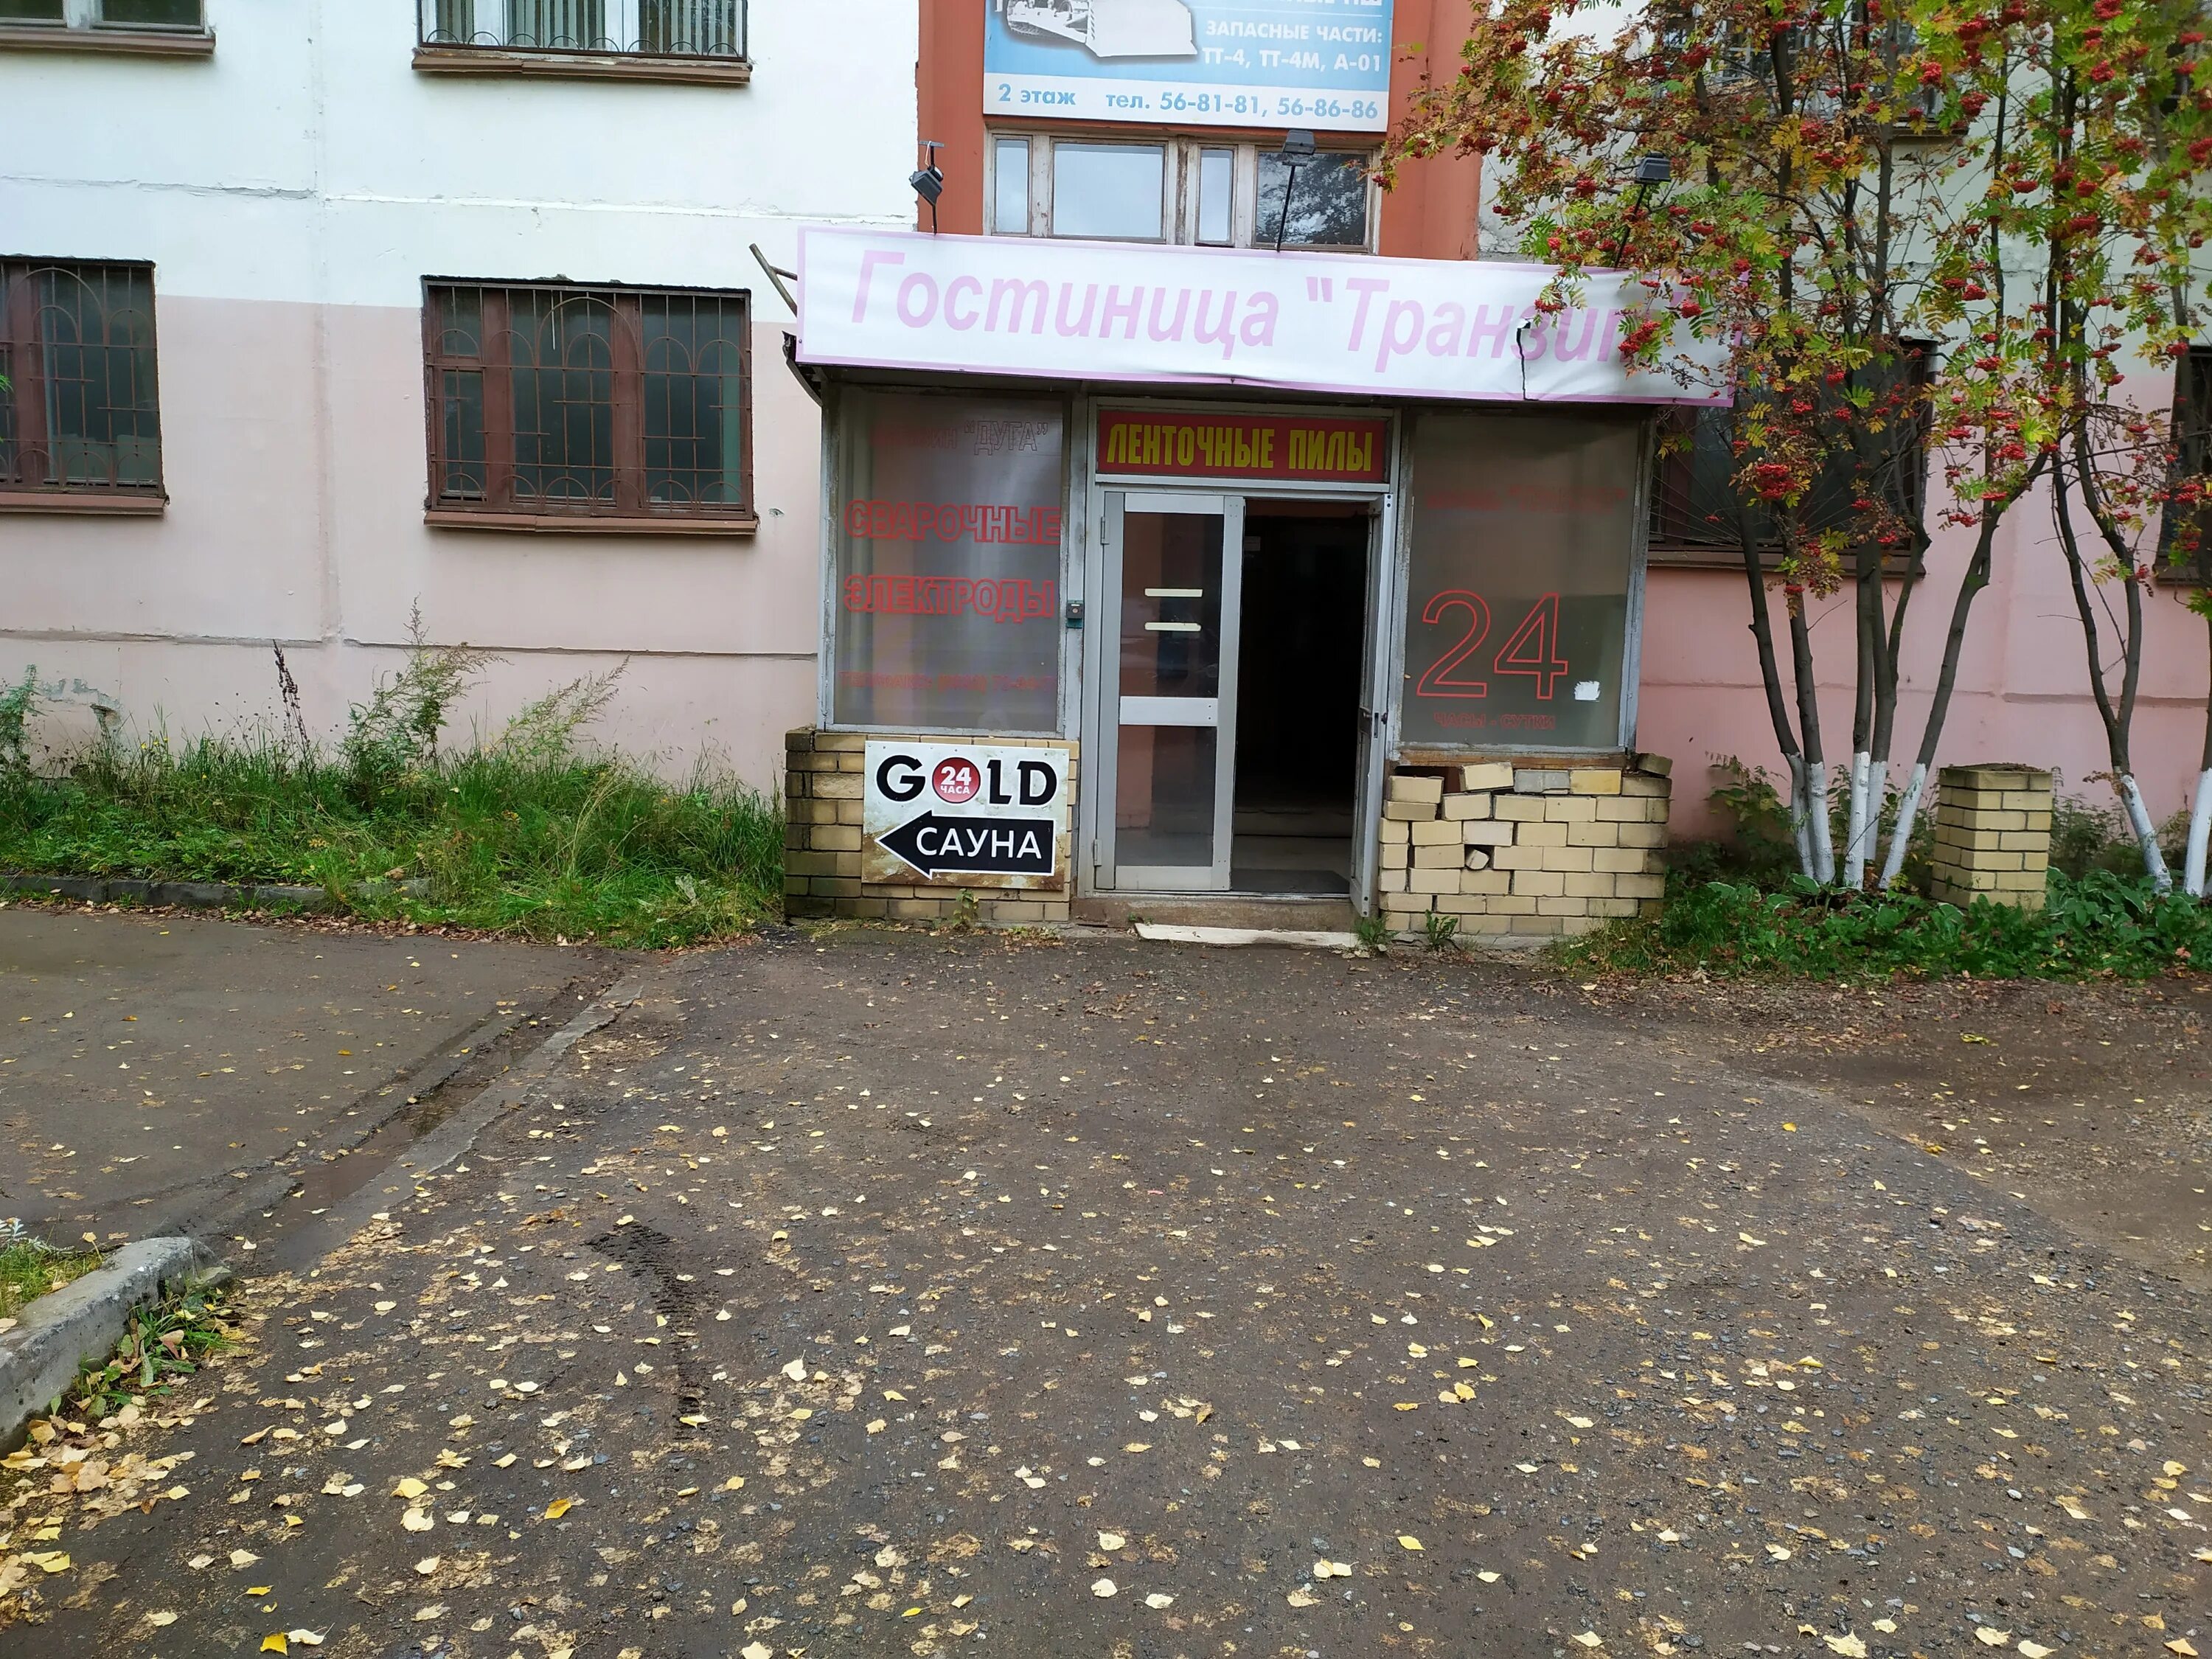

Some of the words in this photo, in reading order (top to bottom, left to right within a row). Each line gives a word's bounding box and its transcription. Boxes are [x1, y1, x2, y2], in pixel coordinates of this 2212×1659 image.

[1206, 19, 1310, 40] ЗАПАСНЫЕ
[1316, 25, 1383, 44] ЧАСТИ:
[1202, 46, 1251, 69] ТТ-4,
[1259, 49, 1326, 72] ТТ-4М,
[1334, 53, 1381, 72] А-01
[998, 83, 1012, 102] 2
[1020, 88, 1077, 105] этаж
[1106, 93, 1150, 109] тел.
[1159, 91, 1268, 118] 56-81-81,
[1276, 97, 1379, 119] 56-86-86
[851, 249, 1281, 361] Гостиница
[1106, 423, 1275, 469] ЛЕНТОЧНЫЕ
[1288, 429, 1374, 472] ПИЛЫ
[844, 499, 1061, 546] СВАРОЧНЫЕ
[843, 573, 1056, 624] ЭЛЕКТРОДЫ
[1416, 589, 1569, 700] 24
[1433, 712, 1487, 729] ЧАСЫ
[1499, 714, 1557, 730] СУТКИ
[876, 754, 1058, 807] GOLD
[940, 766, 972, 786] 24
[940, 785, 970, 794] ЧАСА
[915, 827, 1043, 860] САУНА
